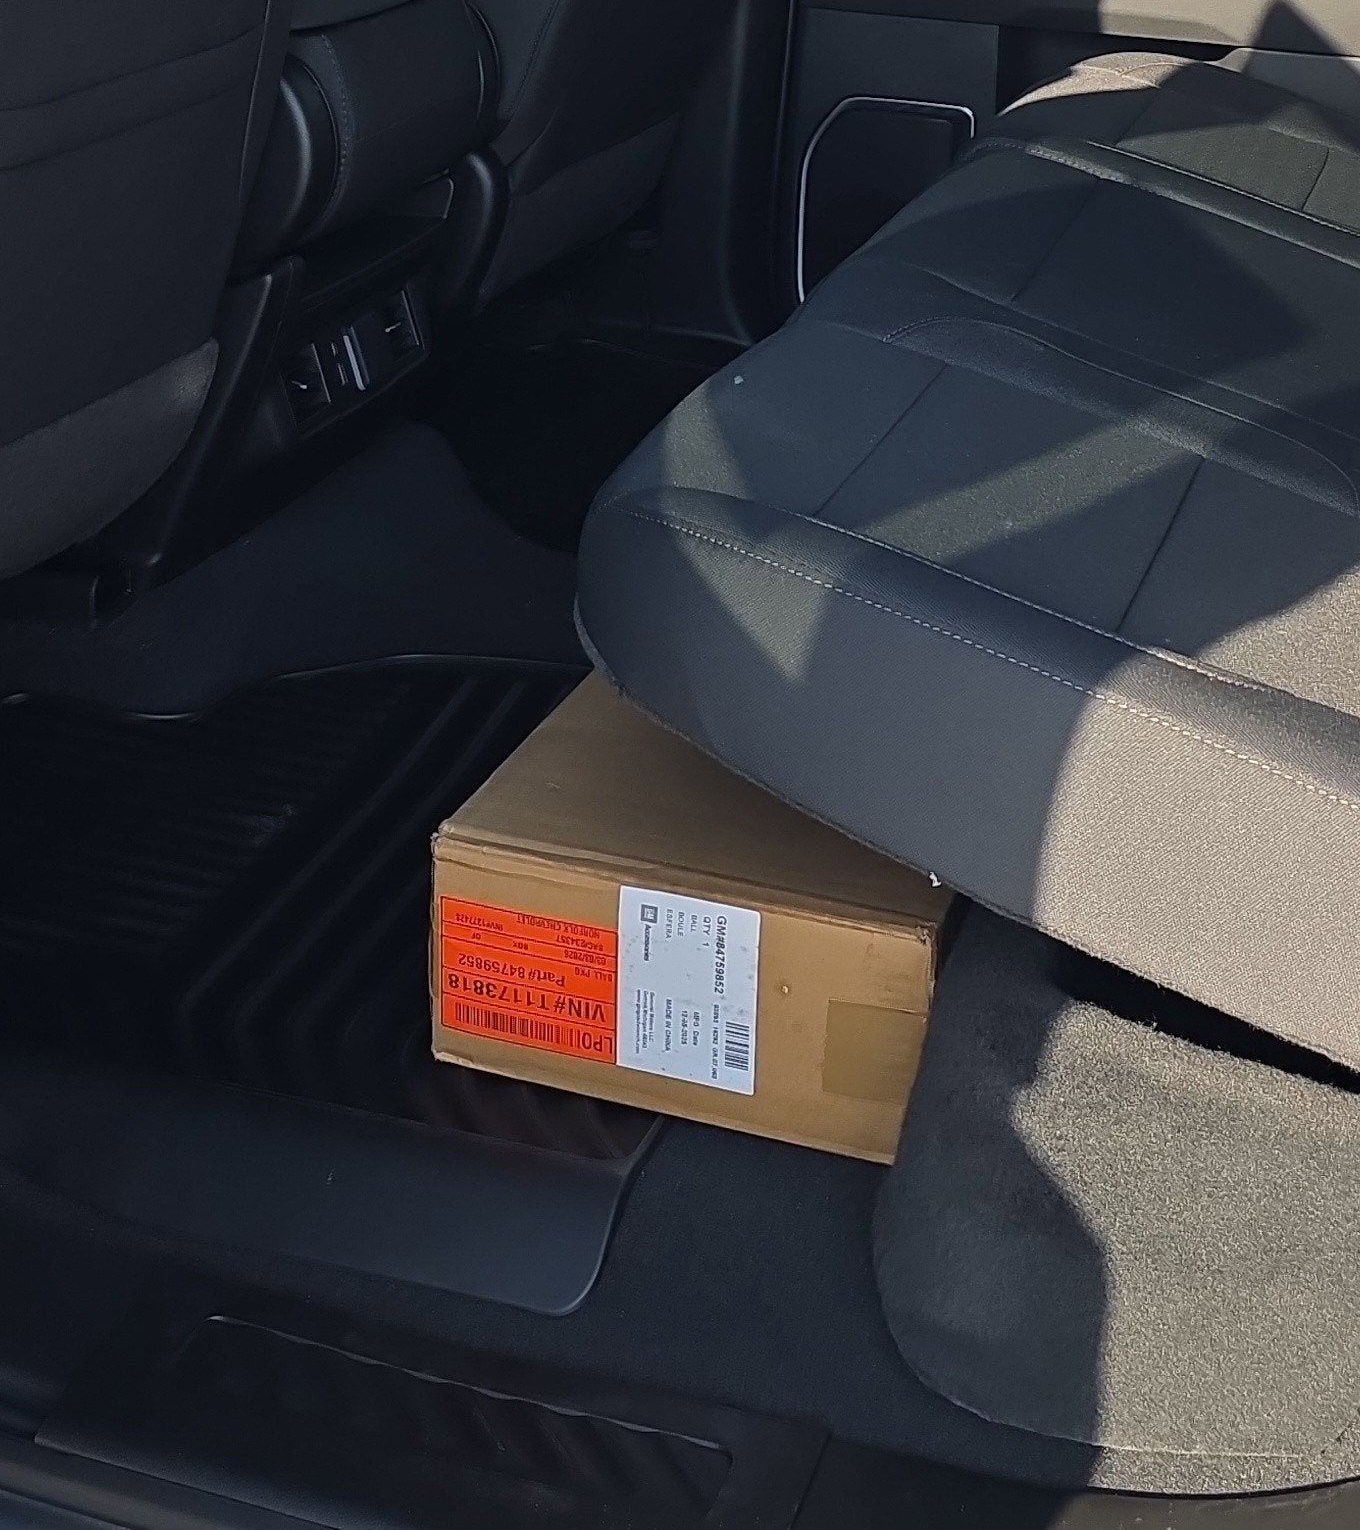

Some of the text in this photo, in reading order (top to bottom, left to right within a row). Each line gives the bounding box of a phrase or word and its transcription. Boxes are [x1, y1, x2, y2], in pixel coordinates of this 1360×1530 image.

[702, 916, 712, 936] QTY
[458, 953, 566, 987] Part# 84759852
[714, 915, 728, 995] GM#84759852
[448, 973, 607, 1022] VIN# T1173818
